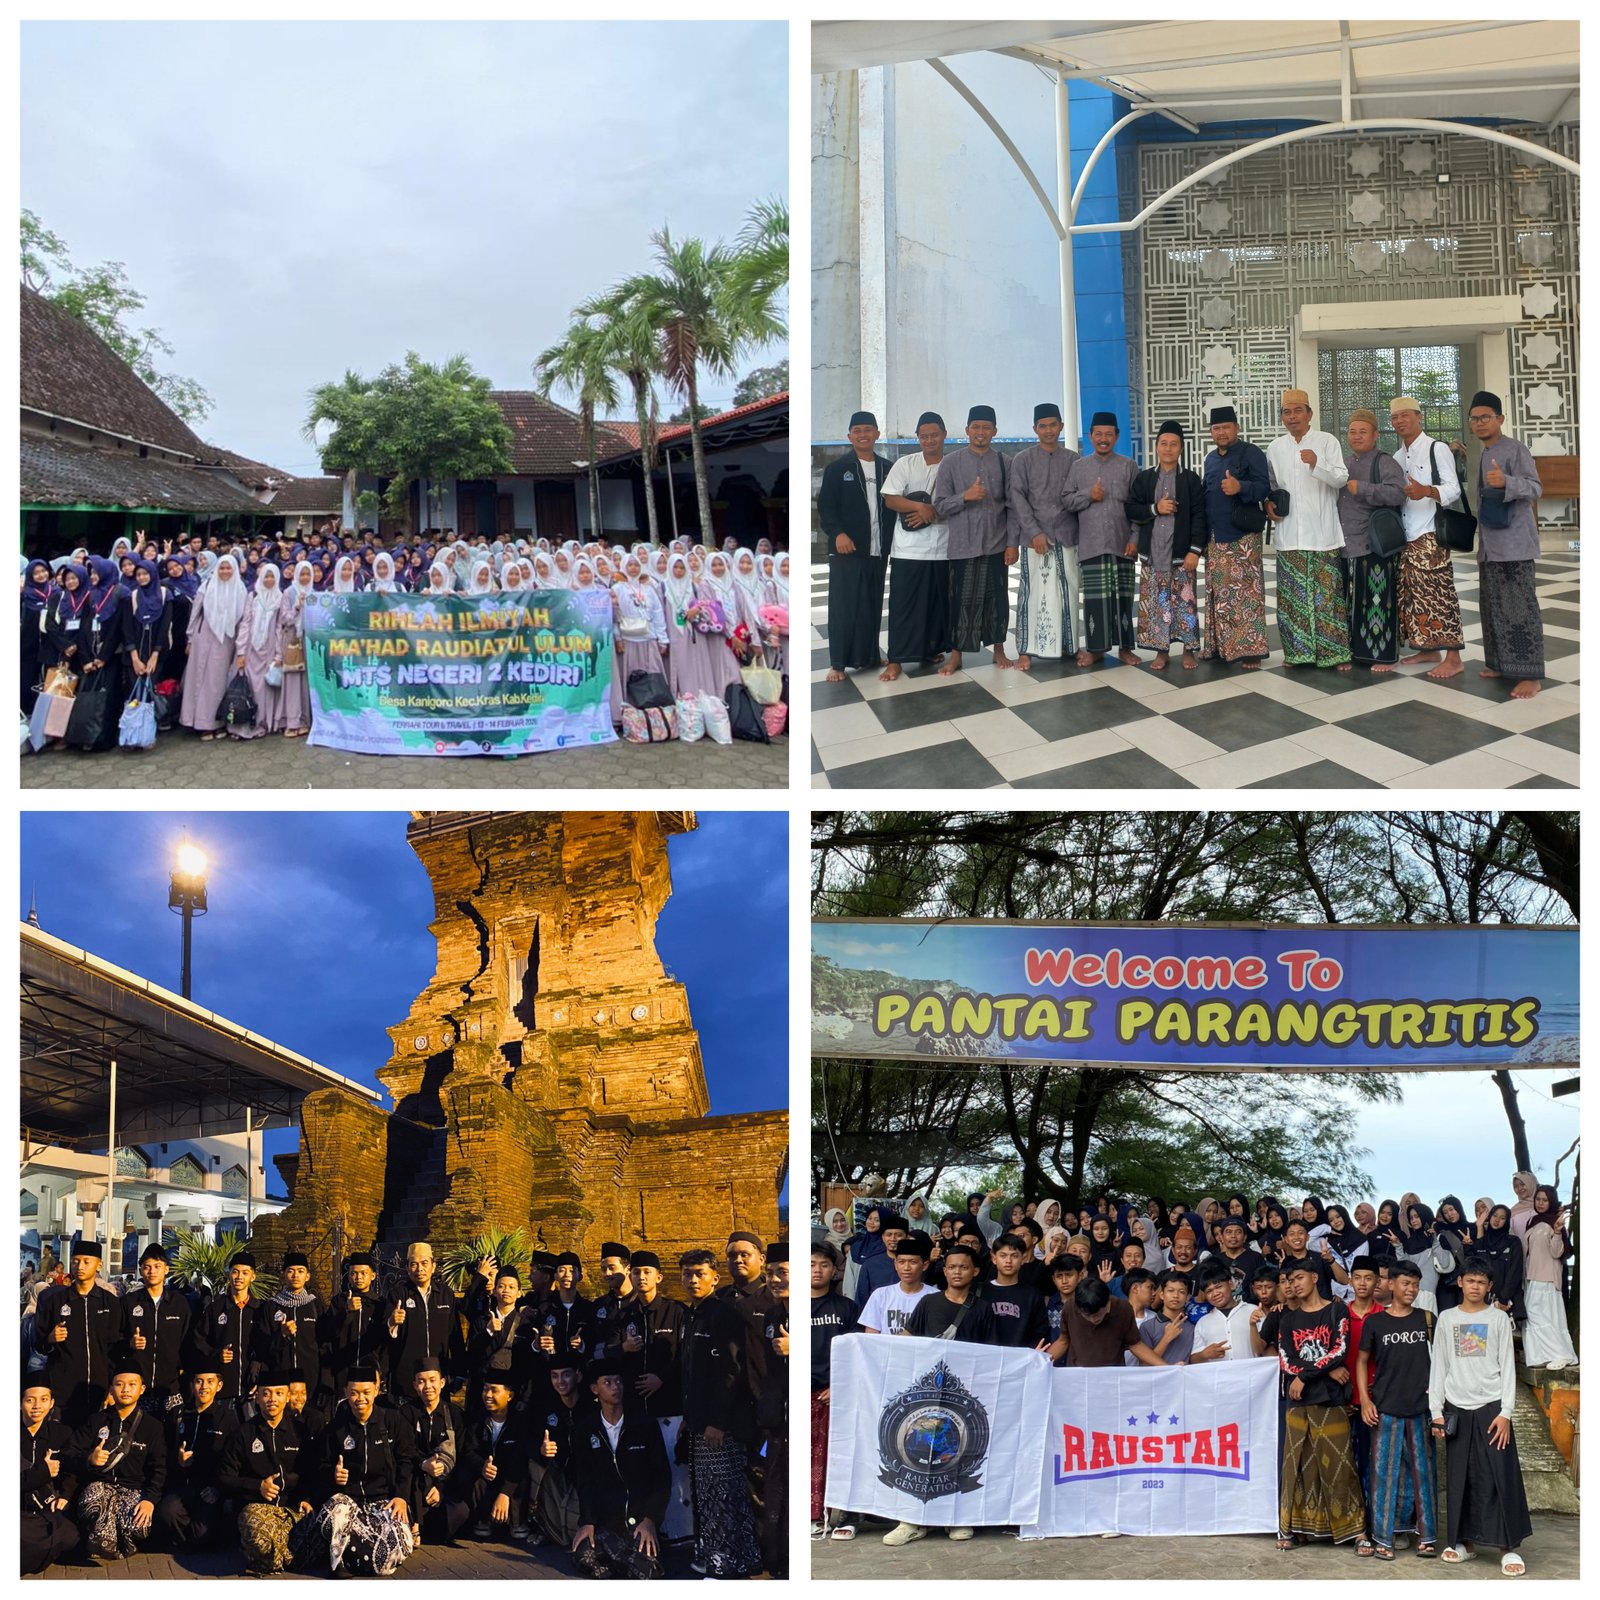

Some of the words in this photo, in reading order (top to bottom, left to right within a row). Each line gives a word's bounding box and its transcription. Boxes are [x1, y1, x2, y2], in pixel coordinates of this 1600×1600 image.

[368, 610, 453, 631] RIHLAH
[458, 608, 551, 631] ILMIYAH
[329, 637, 410, 657] MA'HAD
[416, 634, 530, 657] RAUDIATUL
[534, 634, 593, 653] ULUM
[342, 665, 392, 688] MTS
[397, 663, 483, 686] NEGERI
[487, 661, 502, 683] 2
[507, 660, 581, 687] KEDIRI
[407, 694, 453, 710] Kanigoro
[1024, 947, 1268, 990] Welcome
[1277, 948, 1344, 993] To
[875, 993, 1095, 1042] PANTAI
[1118, 998, 1538, 1048] PARANGTRITIS
[1382, 1330, 1426, 1346] FORCE
[1063, 1422, 1241, 1473] RAUSTAR
[894, 1477, 961, 1493] GENERATION
[904, 1471, 950, 1485] RAUSTAR
[1141, 1479, 1165, 1489] 2023
